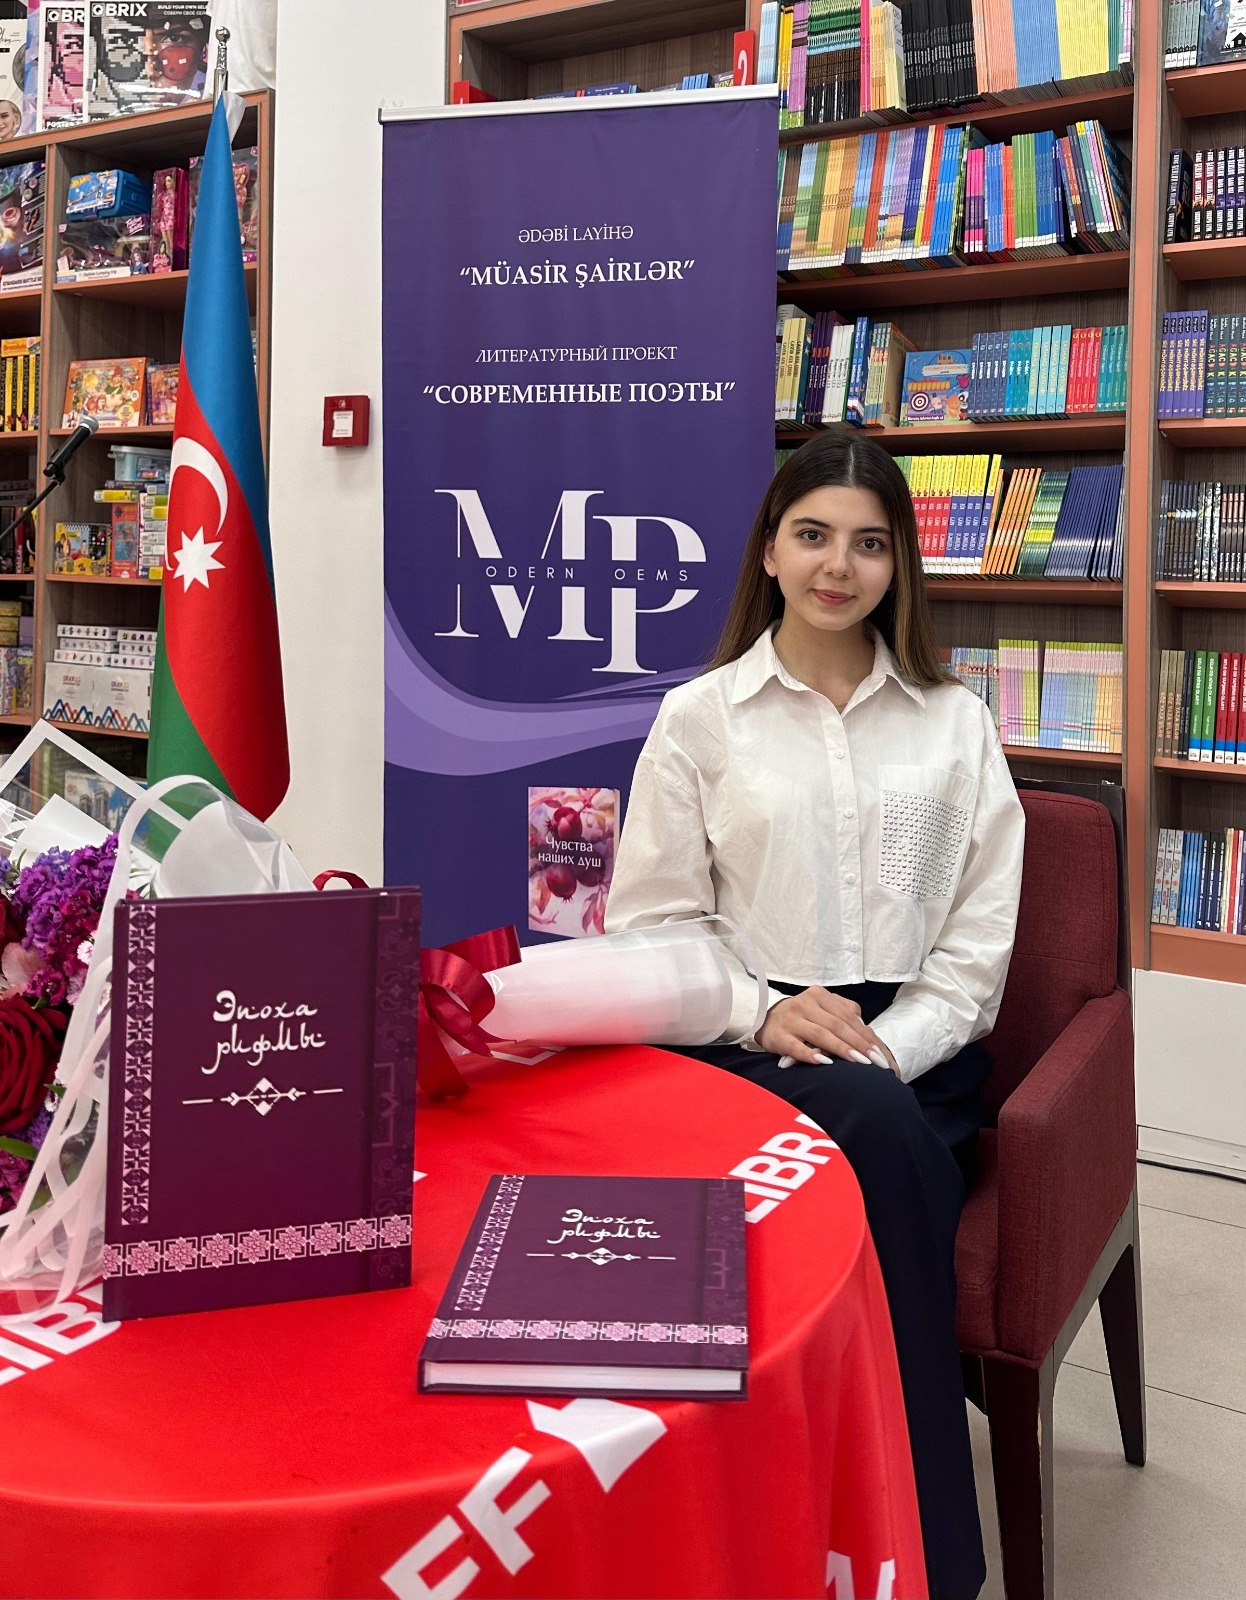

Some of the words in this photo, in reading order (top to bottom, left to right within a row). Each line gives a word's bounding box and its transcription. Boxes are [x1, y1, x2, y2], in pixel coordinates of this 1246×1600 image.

[92, 3, 148, 17] QBRIX
[518, 226, 568, 243] ƏDƏBİ
[573, 224, 634, 242] LAYİHƏ
[475, 344, 608, 362] ЛИТЕРАТУРНЫЙ
[612, 346, 678, 361] ПРОЕКТ
[546, 836, 593, 853] Чувства
[538, 852, 574, 866] наших
[578, 858, 601, 870] душ
[213, 990, 318, 1022] Эпоха
[561, 1208, 654, 1225] Эпоха
